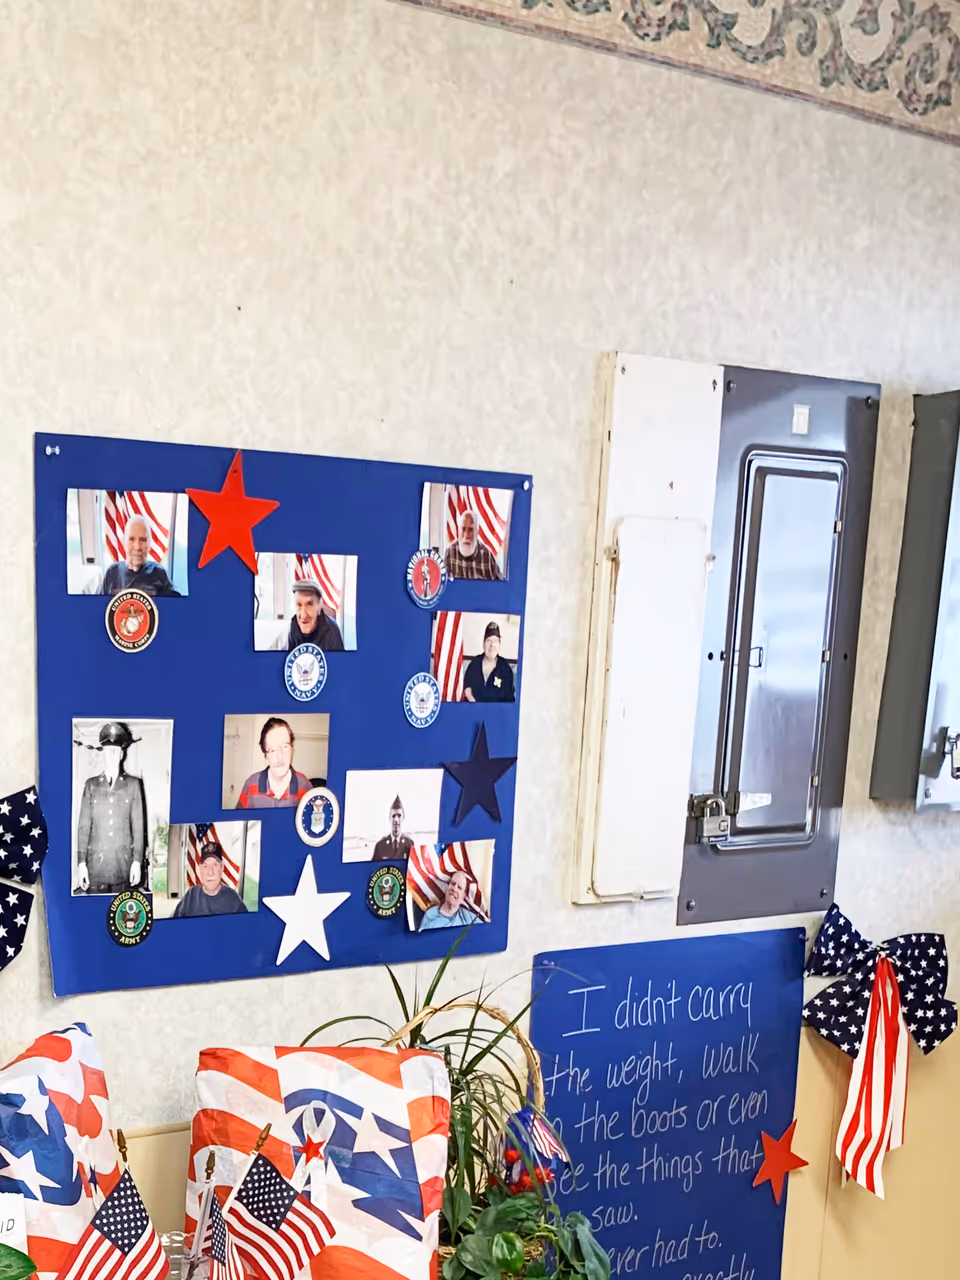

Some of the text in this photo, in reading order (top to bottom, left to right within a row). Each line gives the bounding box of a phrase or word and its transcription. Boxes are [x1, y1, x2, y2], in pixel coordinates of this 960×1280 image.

[407, 549, 447, 580] NATIONAL GUARD
[112, 593, 152, 611] UNITED STATES
[115, 633, 150, 648] MARINE CORPS
[287, 647, 325, 684] UNITED STATES
[294, 686, 318, 699] NAVY
[405, 675, 439, 711] UNITED STATES
[411, 715, 432, 725] NAVY
[369, 866, 404, 887] UNITED STATES
[111, 891, 151, 912] UNITED STATES
[377, 907, 396, 916] ARMY
[119, 936, 141, 945] ARMY
[562, 975, 753, 1037] I didn't carry
[544, 1050, 593, 1097] the
[606, 1040, 683, 1106] weight,
[574, 1100, 624, 1143] the
[631, 1097, 688, 1139] boots
[696, 1094, 726, 1131] or
[727, 1089, 768, 1125] even
[593, 1150, 631, 1192] the
[635, 1143, 704, 1193] things
[711, 1134, 765, 1175] that
[591, 1201, 638, 1233] saw.
[607, 1219, 723, 1276] ever had to.
